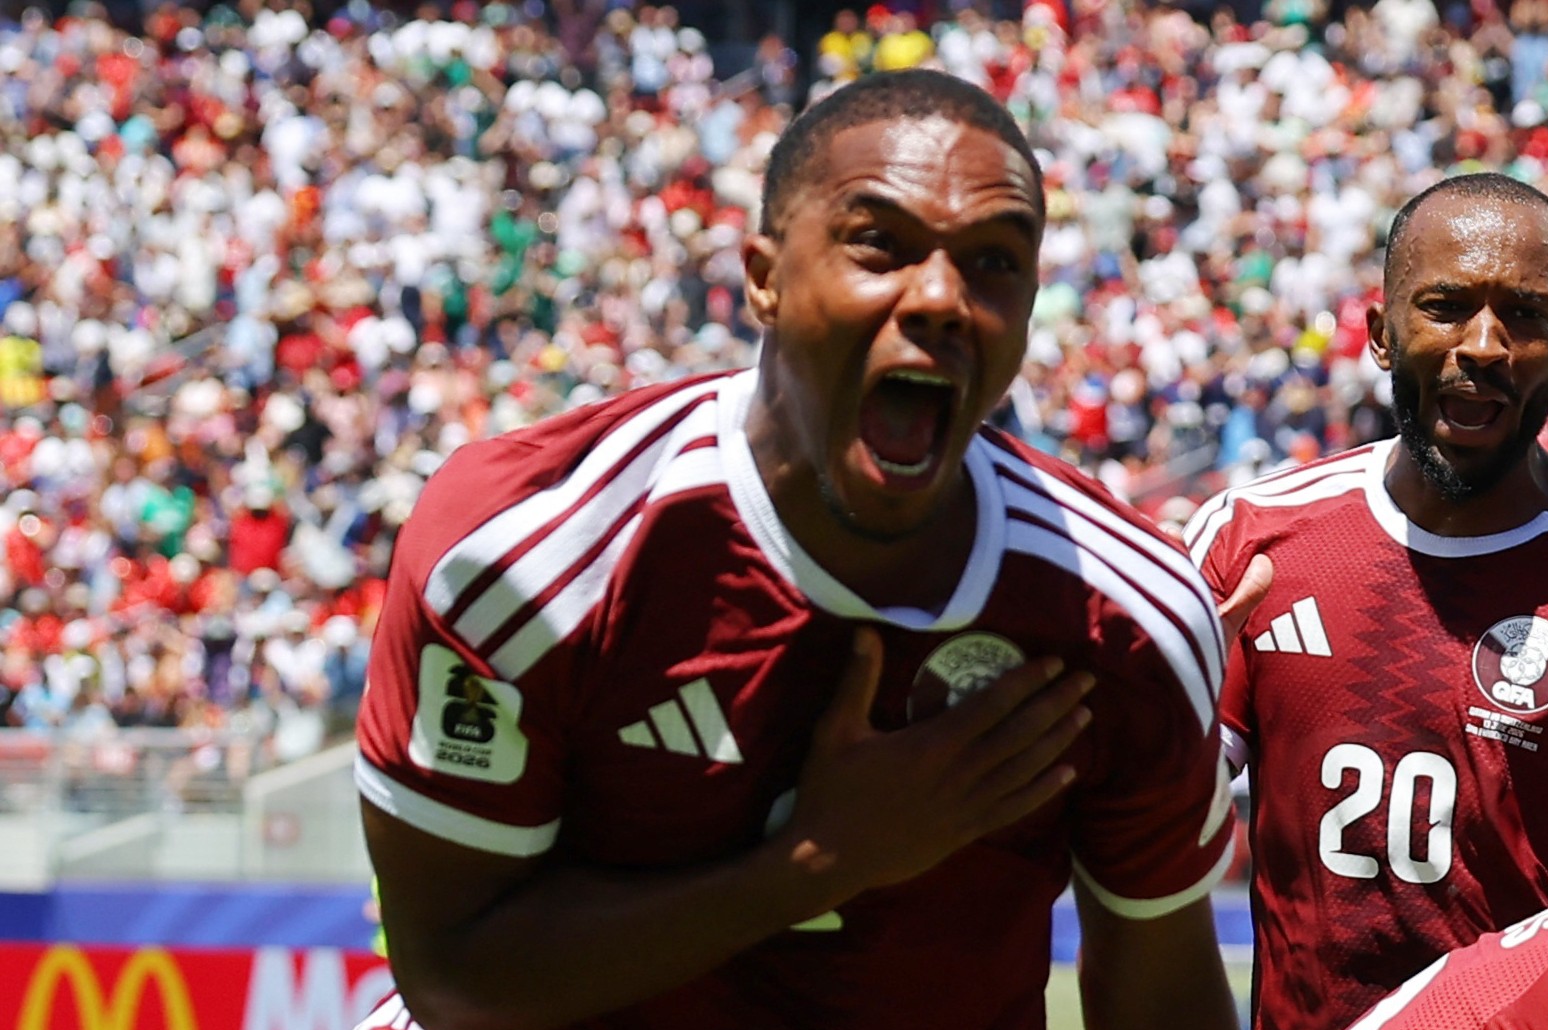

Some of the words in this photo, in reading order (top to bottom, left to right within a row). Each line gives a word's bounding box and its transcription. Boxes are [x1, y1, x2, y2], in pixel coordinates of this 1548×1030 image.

[1492, 680, 1535, 709] QFA
[436, 752, 491, 768] 2026
[1319, 743, 1457, 884] 20
